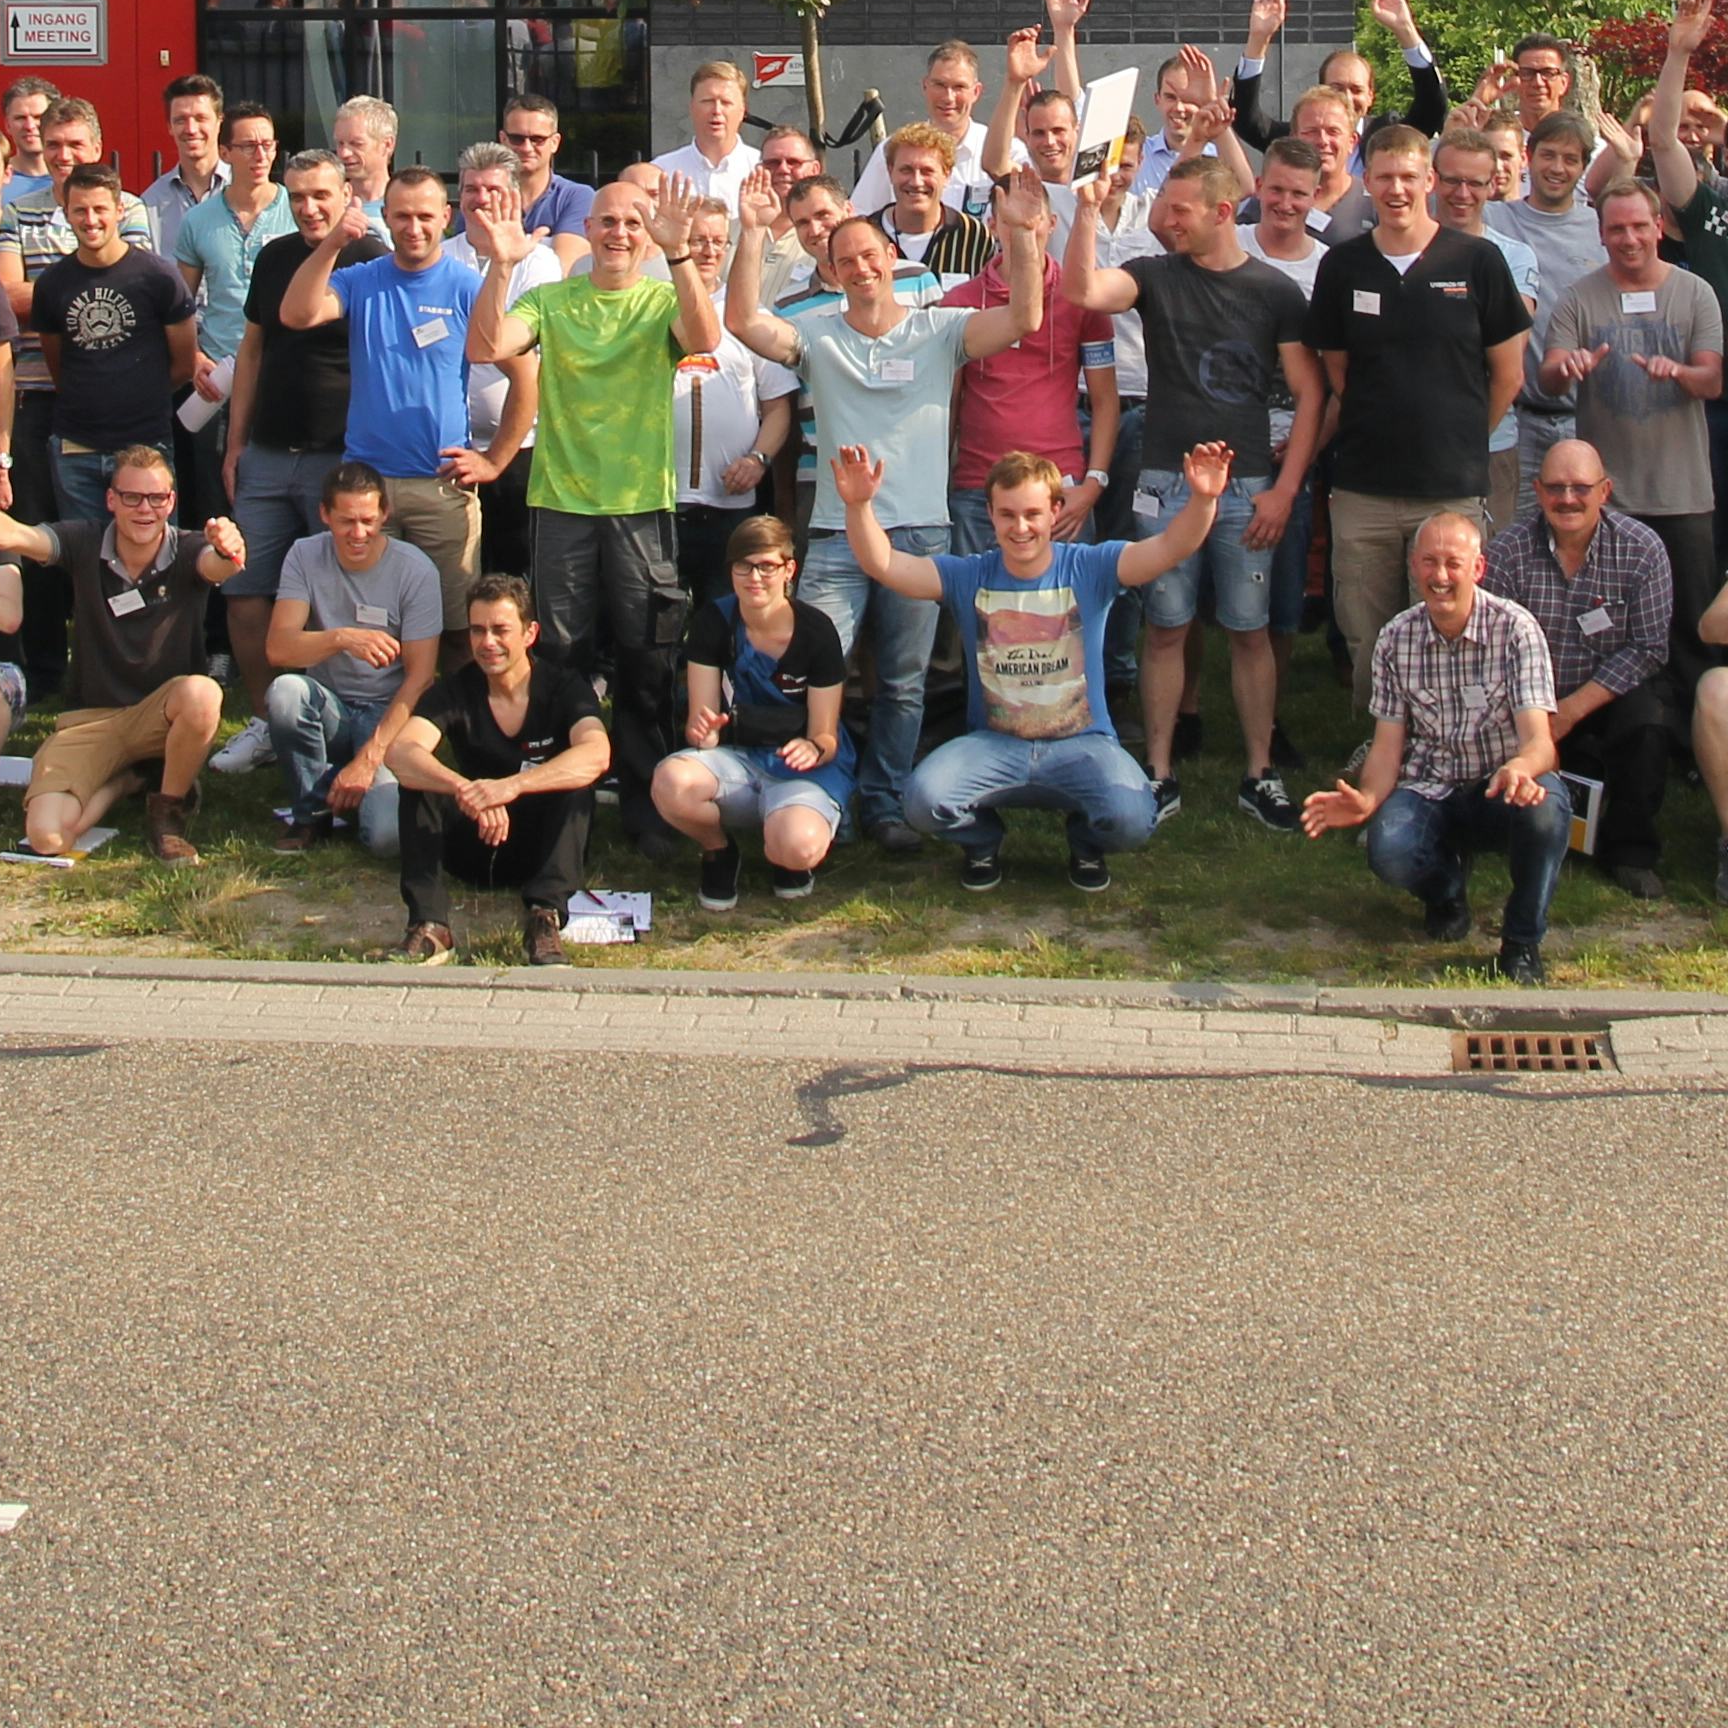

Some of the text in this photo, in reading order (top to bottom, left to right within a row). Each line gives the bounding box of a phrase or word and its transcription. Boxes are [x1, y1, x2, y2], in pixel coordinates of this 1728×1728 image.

[28, 13, 87, 25] INGANG
[24, 31, 92, 43] MEETING
[995, 656, 1070, 676] AMERICAN DREAM
